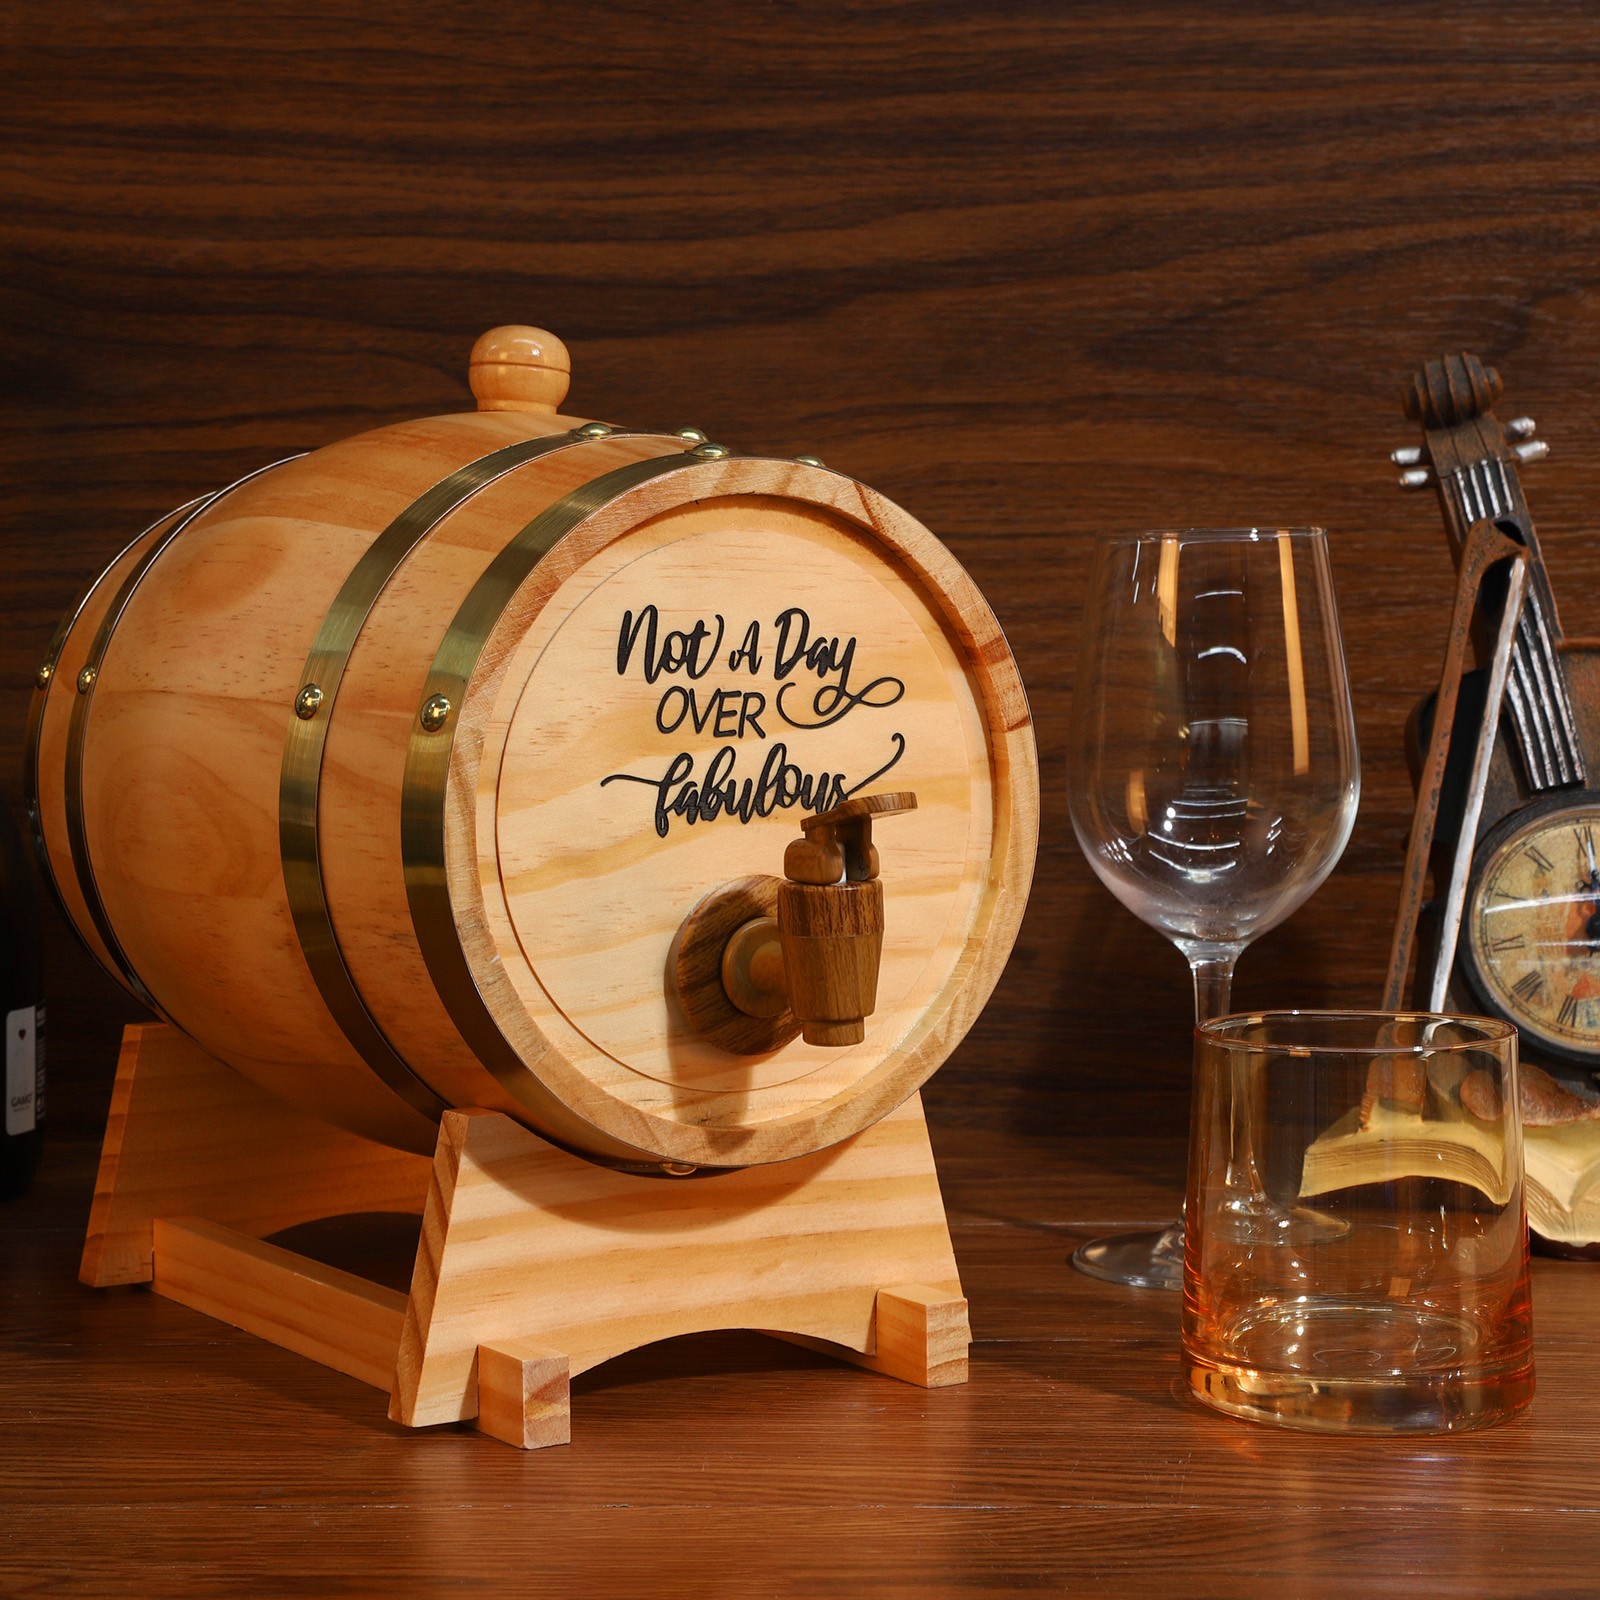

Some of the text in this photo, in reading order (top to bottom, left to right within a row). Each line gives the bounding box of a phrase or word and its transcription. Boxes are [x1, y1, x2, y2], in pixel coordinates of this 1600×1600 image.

[616, 604, 905, 729] Not A Day
[656, 685, 767, 739] OVER
[600, 732, 905, 838] fabulous
